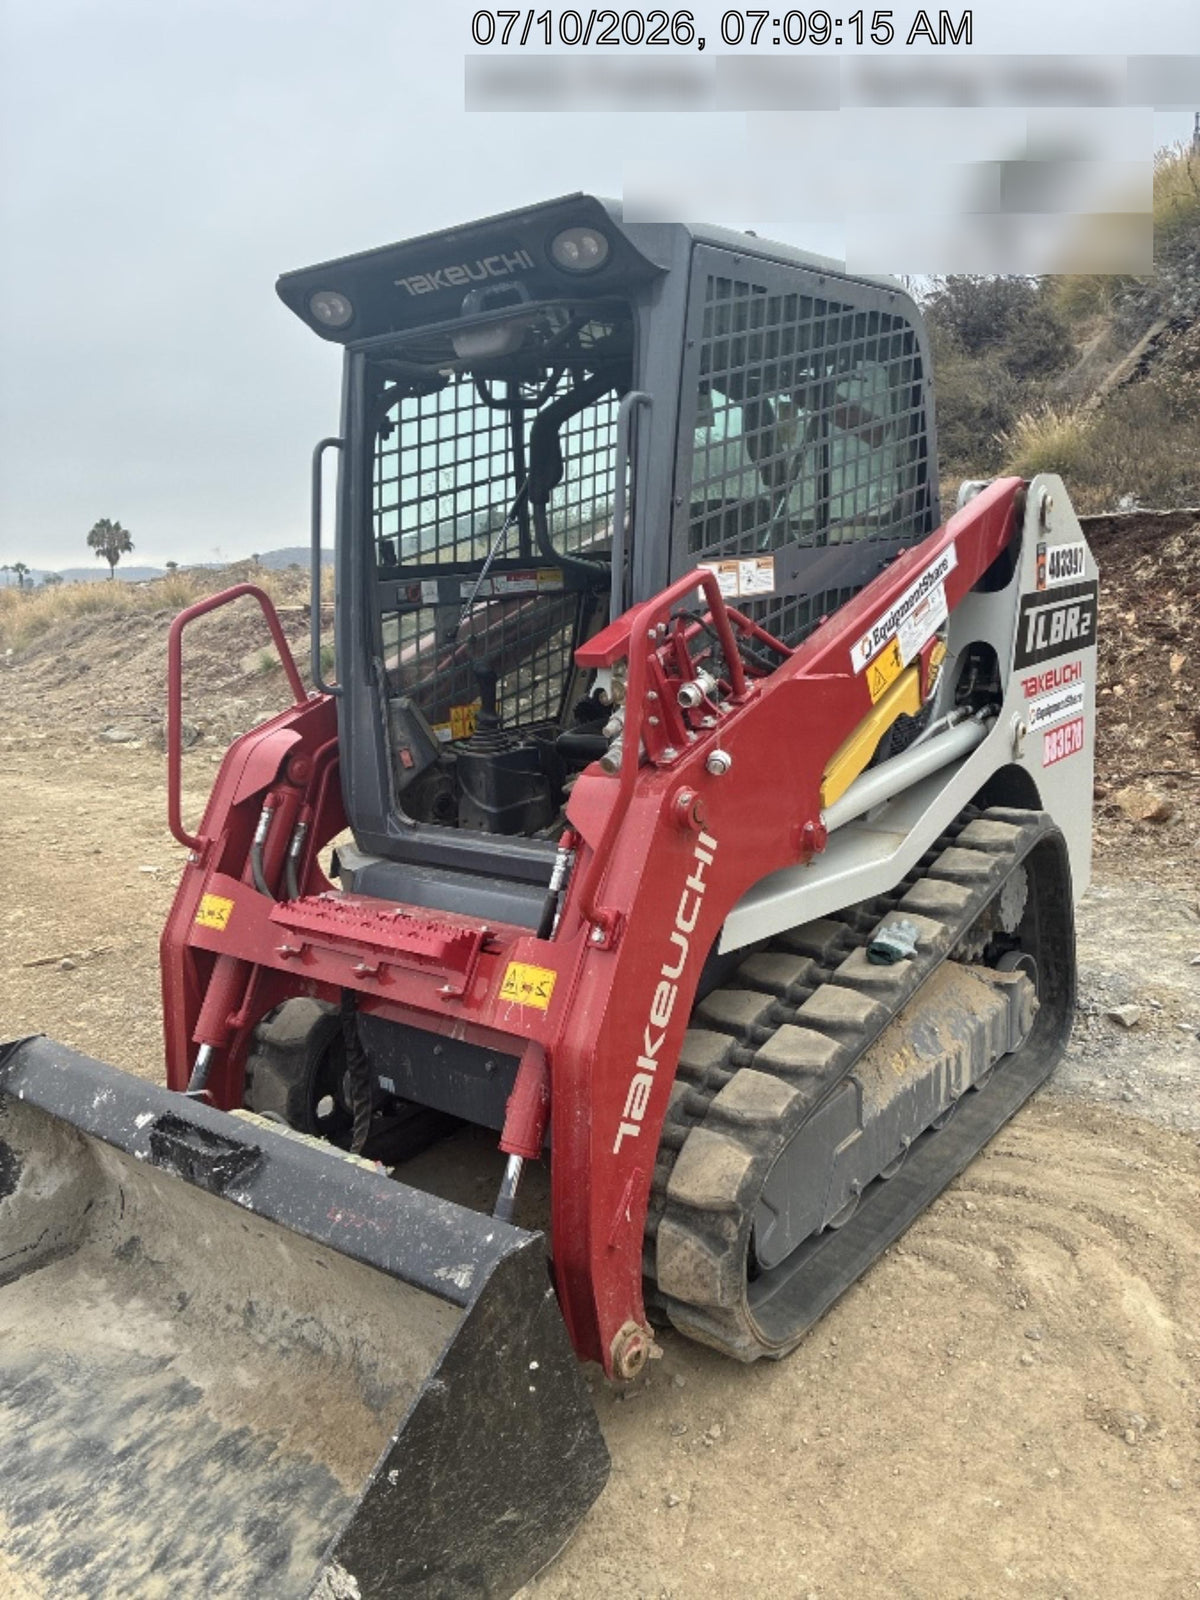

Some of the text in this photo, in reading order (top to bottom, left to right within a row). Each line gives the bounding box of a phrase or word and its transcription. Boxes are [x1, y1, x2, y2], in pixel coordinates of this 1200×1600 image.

[394, 250, 535, 296] TAKEUCHI
[872, 558, 949, 647] EquipmentShare
[1020, 660, 1082, 699] TAKEUCHI
[613, 831, 718, 1155] TAKEUCHI
